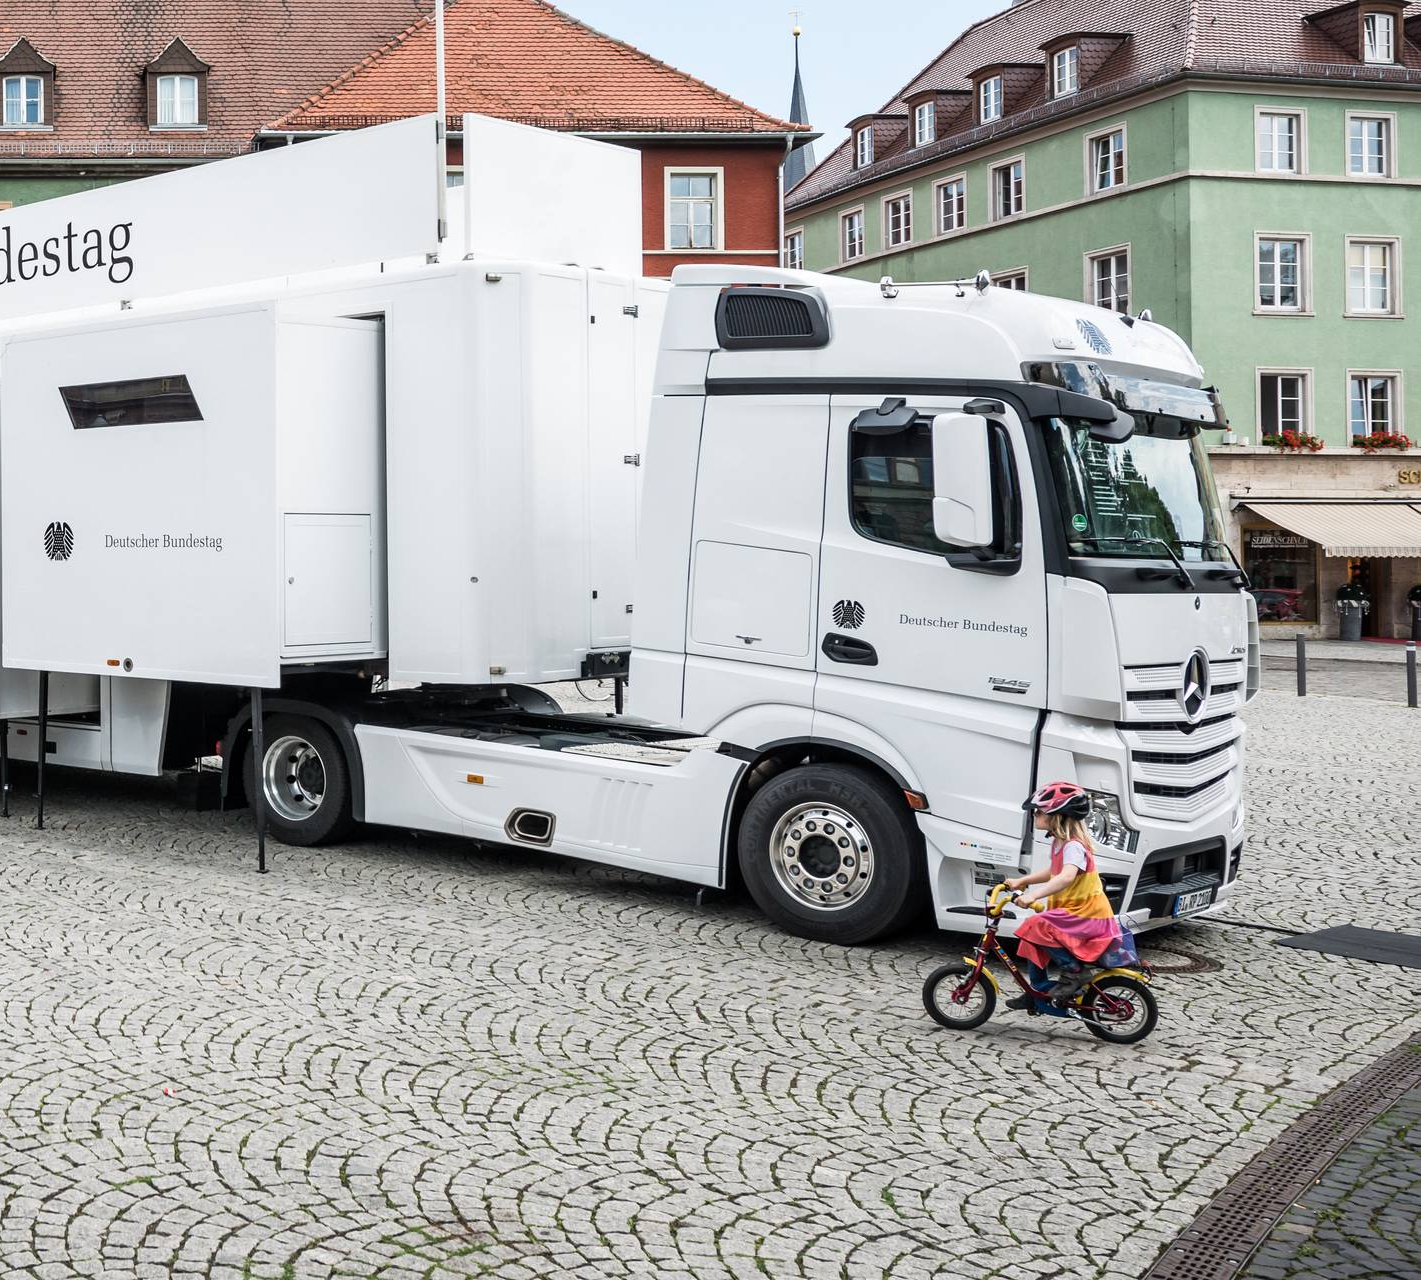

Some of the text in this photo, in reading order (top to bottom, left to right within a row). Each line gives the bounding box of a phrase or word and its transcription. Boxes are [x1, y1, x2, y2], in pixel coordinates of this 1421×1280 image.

[1397, 470, 1421, 484] SC
[104, 533, 223, 553] Deutscher Bundestag
[898, 613, 1029, 638] Deutscher Bundestag
[987, 676, 1031, 688] 1845
